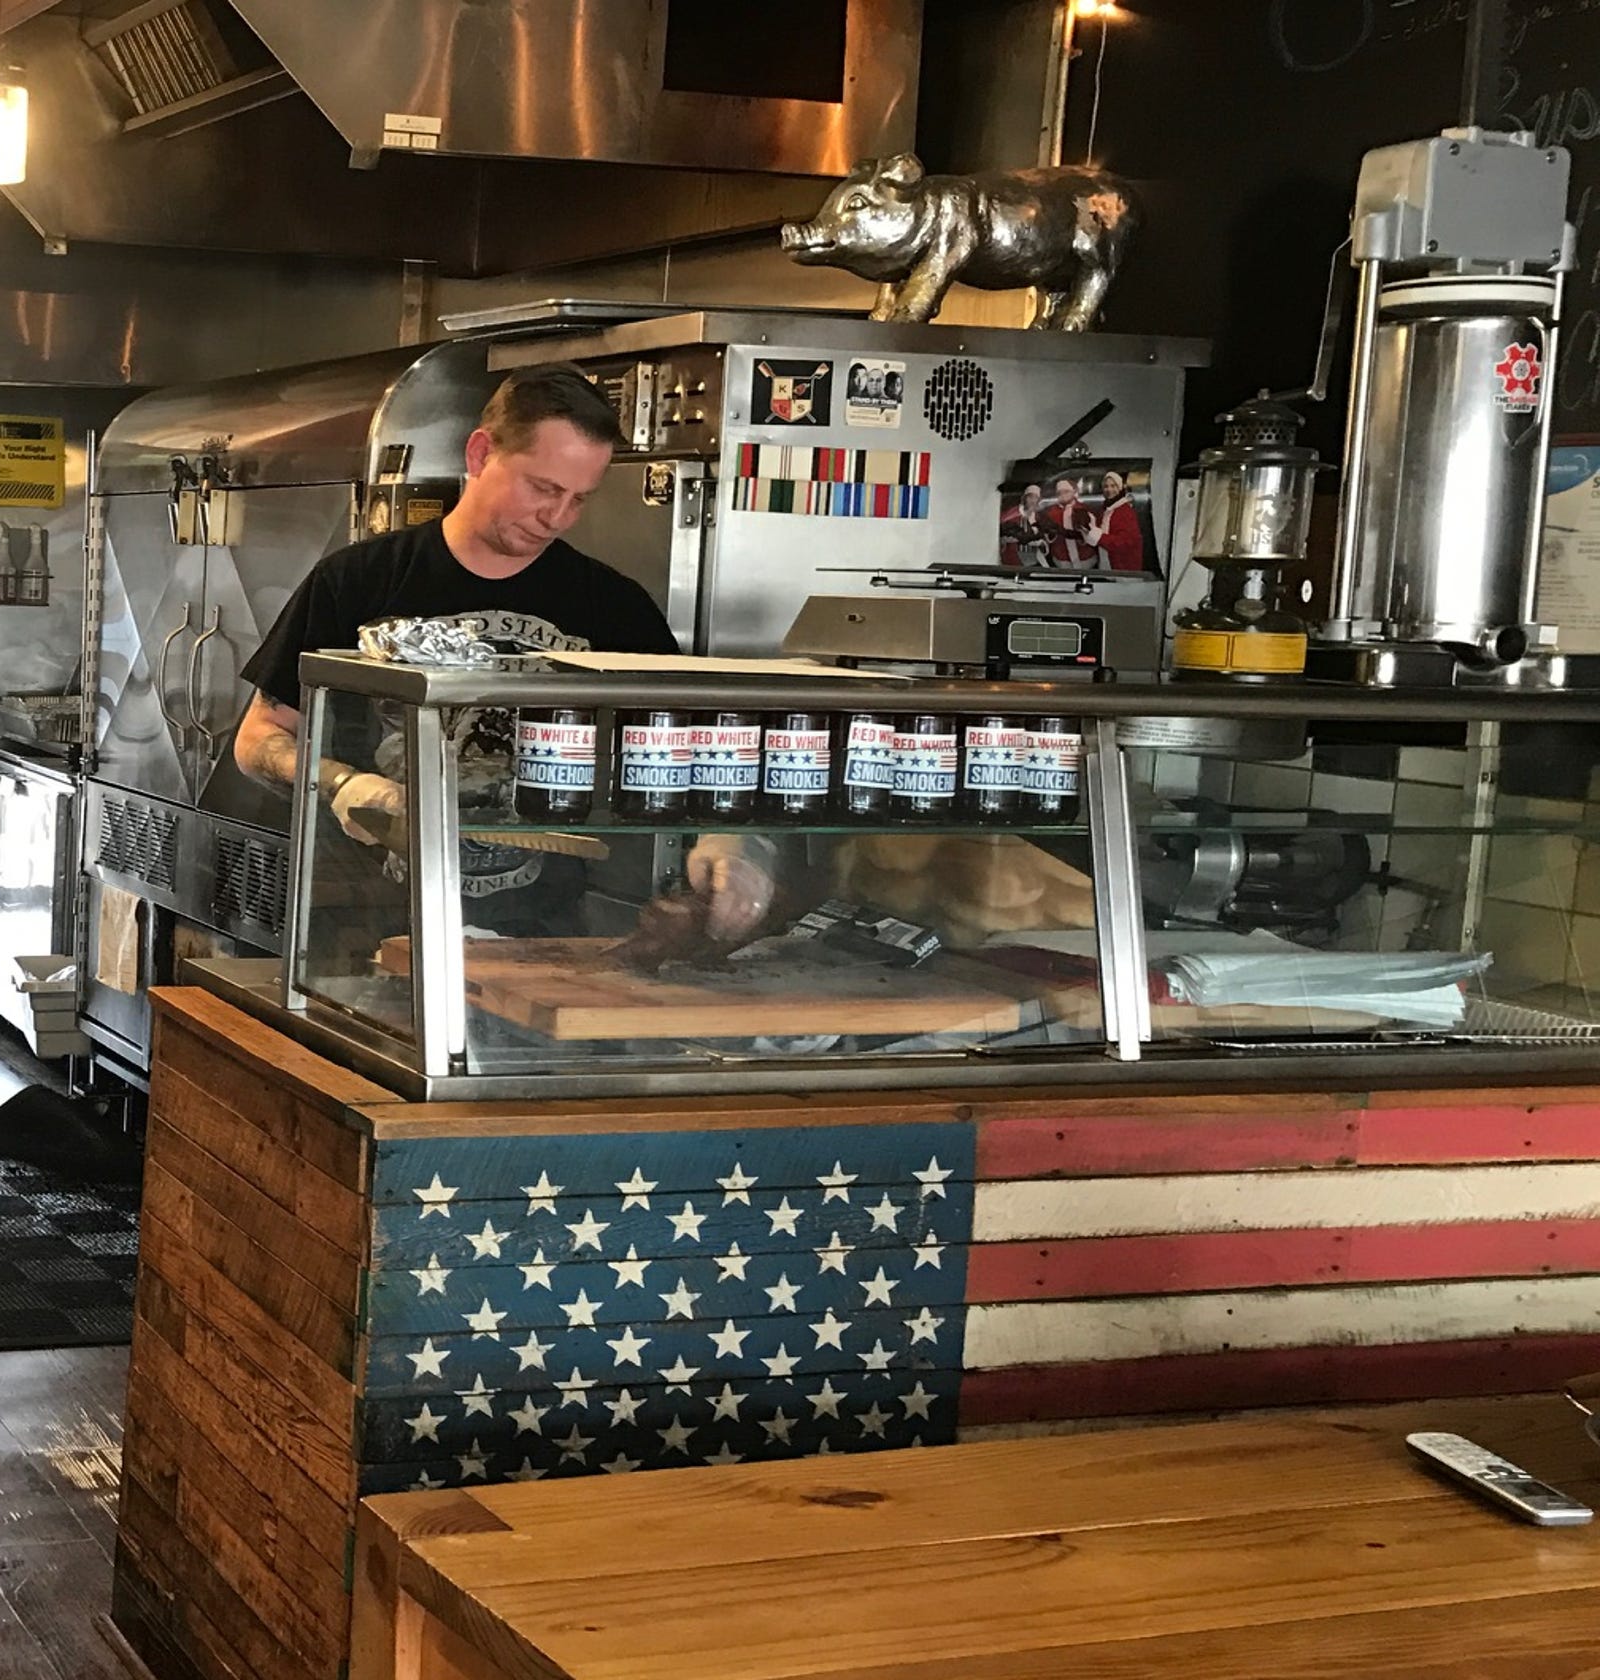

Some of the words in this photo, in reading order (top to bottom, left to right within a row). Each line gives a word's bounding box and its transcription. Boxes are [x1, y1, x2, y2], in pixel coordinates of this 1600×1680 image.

[540, 728, 580, 744] WHITE
[582, 730, 590, 744] &
[625, 731, 647, 745] RED
[651, 732, 687, 746] WHITE
[691, 731, 713, 745] RED
[717, 732, 754, 746] WHITE
[768, 735, 791, 749] RED
[796, 736, 827, 749] WHITE
[852, 727, 876, 742] RED
[969, 731, 992, 745] RED
[893, 738, 916, 751] RED
[626, 766, 690, 786] SMOKEHO
[770, 770, 828, 788] SMOKEH
[851, 761, 893, 783] SMOKE
[971, 767, 1021, 785] SMOKE
[894, 773, 955, 792] SMOKEH
[1025, 771, 1078, 790] MOKEHO
[462, 876, 508, 893] RINE
